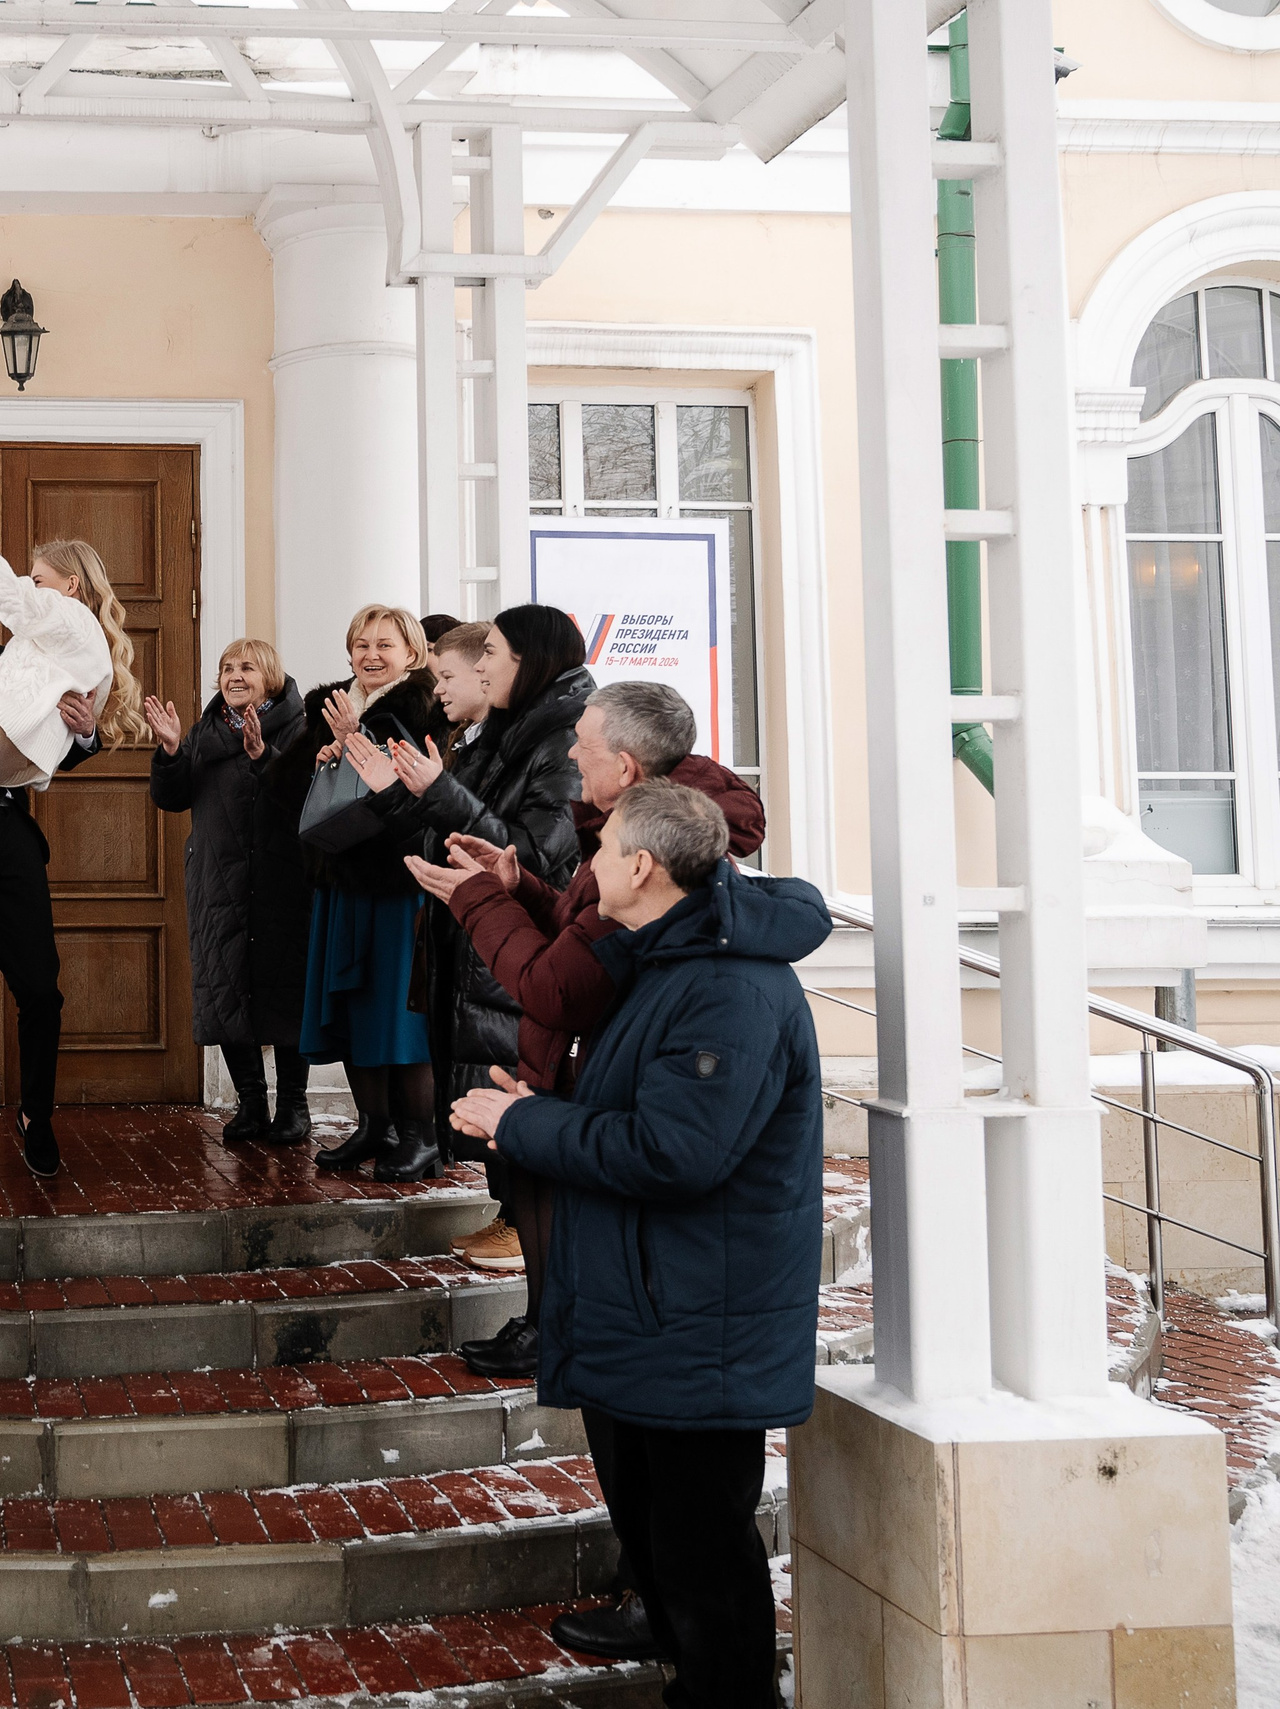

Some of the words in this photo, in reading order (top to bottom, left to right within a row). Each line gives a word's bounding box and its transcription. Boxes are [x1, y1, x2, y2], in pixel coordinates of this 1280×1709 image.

[621, 614, 674, 626] ВЫБОРЫ
[615, 628, 689, 641] ПРЕЗИДЕНТА
[609, 643, 658, 654] РОССИИ
[629, 657, 657, 666] МАРТА
[658, 657, 680, 667] 2024
